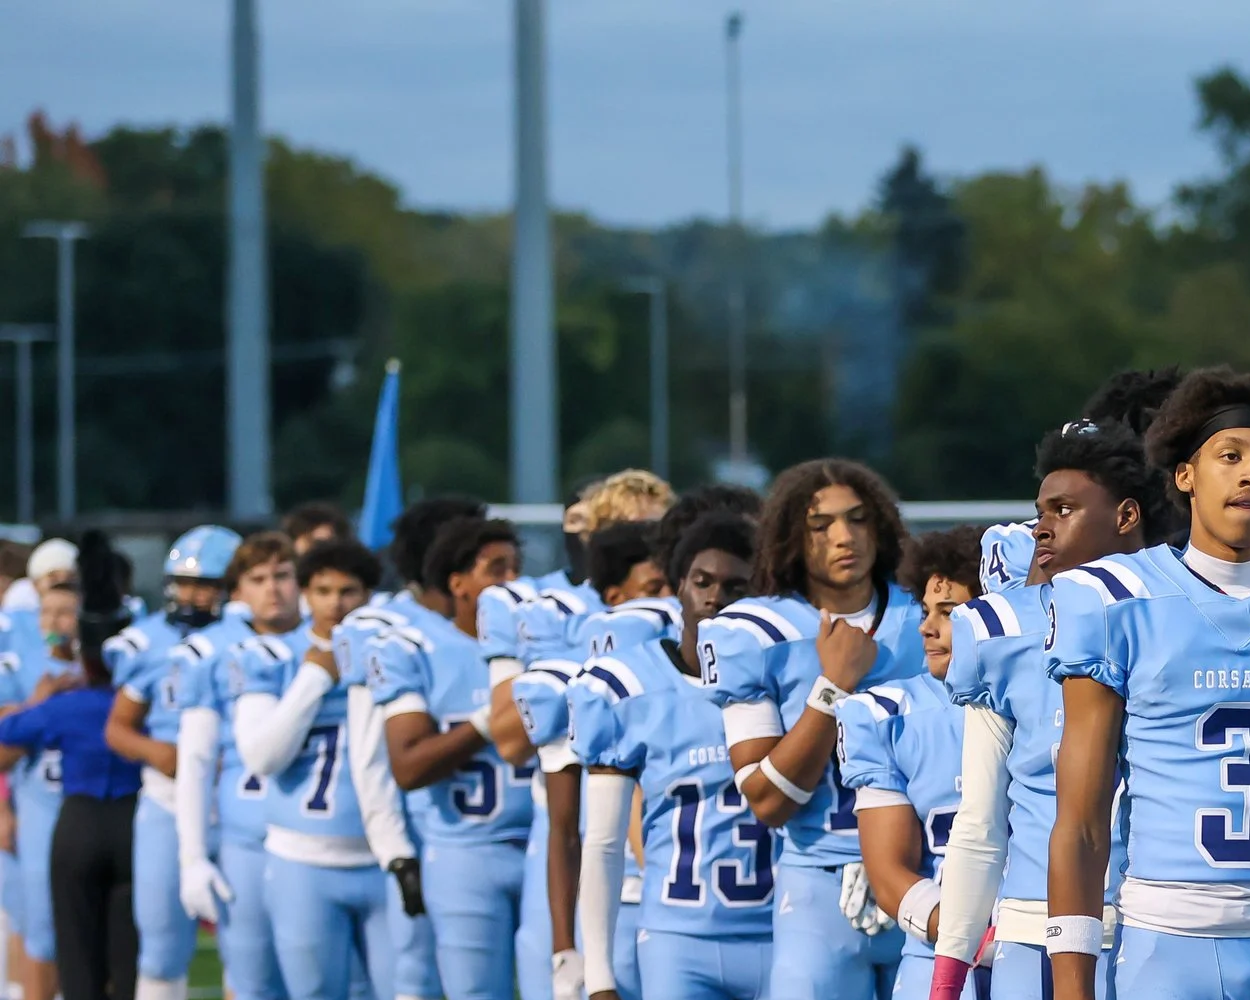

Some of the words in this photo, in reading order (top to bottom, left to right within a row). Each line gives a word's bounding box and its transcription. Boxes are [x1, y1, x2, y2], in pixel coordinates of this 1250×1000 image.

[1044, 599, 1058, 653] 3
[301, 712, 346, 820] 7
[688, 745, 730, 766] CORS
[660, 776, 777, 908] 13
